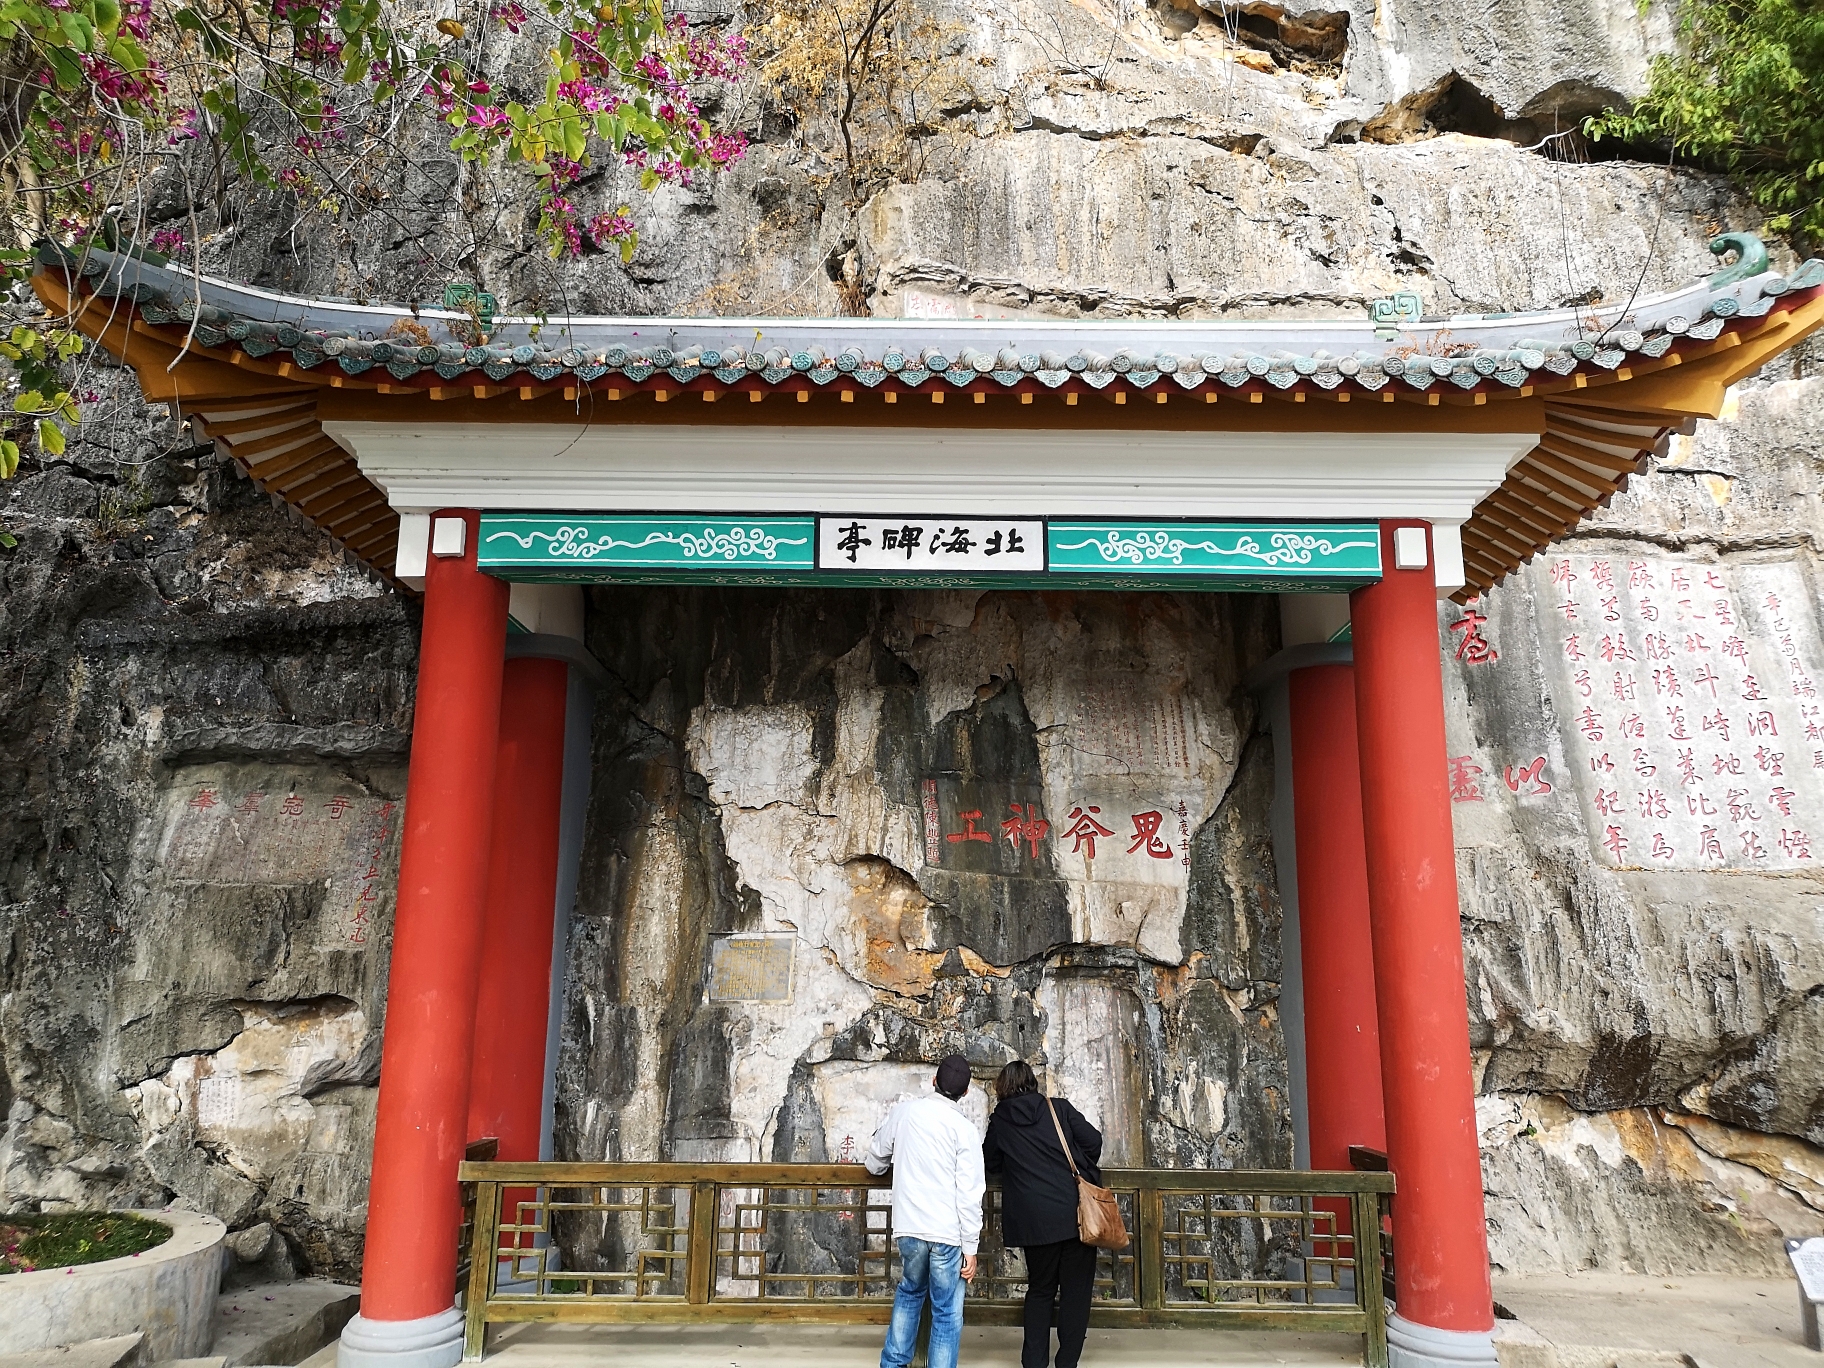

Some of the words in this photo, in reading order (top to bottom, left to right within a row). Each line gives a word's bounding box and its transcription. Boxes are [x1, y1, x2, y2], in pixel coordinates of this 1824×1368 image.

[837, 522, 1025, 563] 北海碑亭
[946, 803, 1174, 860] 鬼斧神工
